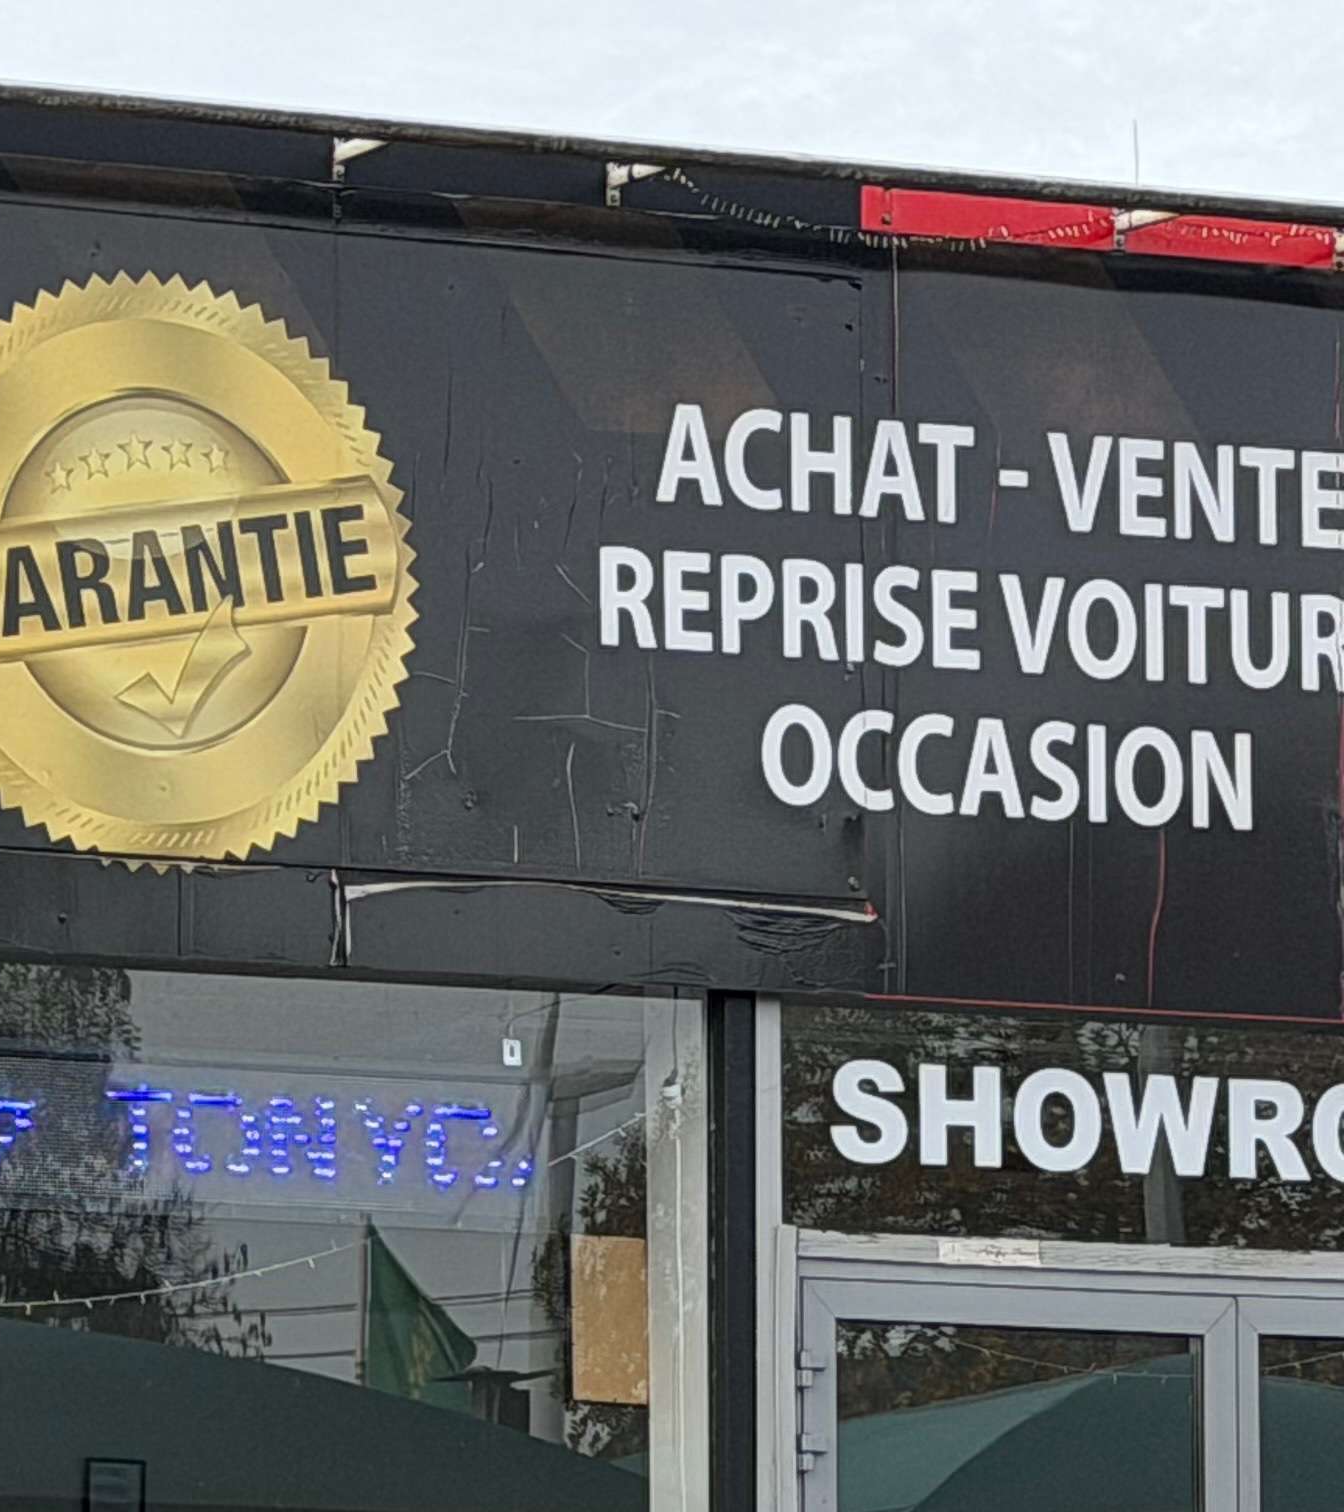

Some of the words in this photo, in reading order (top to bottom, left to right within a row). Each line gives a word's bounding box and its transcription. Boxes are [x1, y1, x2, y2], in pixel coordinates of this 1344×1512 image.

[655, 402, 976, 525] ACHAT
[999, 469, 1030, 489] -
[1047, 431, 1344, 550] VENTE
[599, 546, 981, 671] REPRISE
[1000, 573, 1344, 693] VOITUR
[761, 703, 1254, 832] OCCASION
